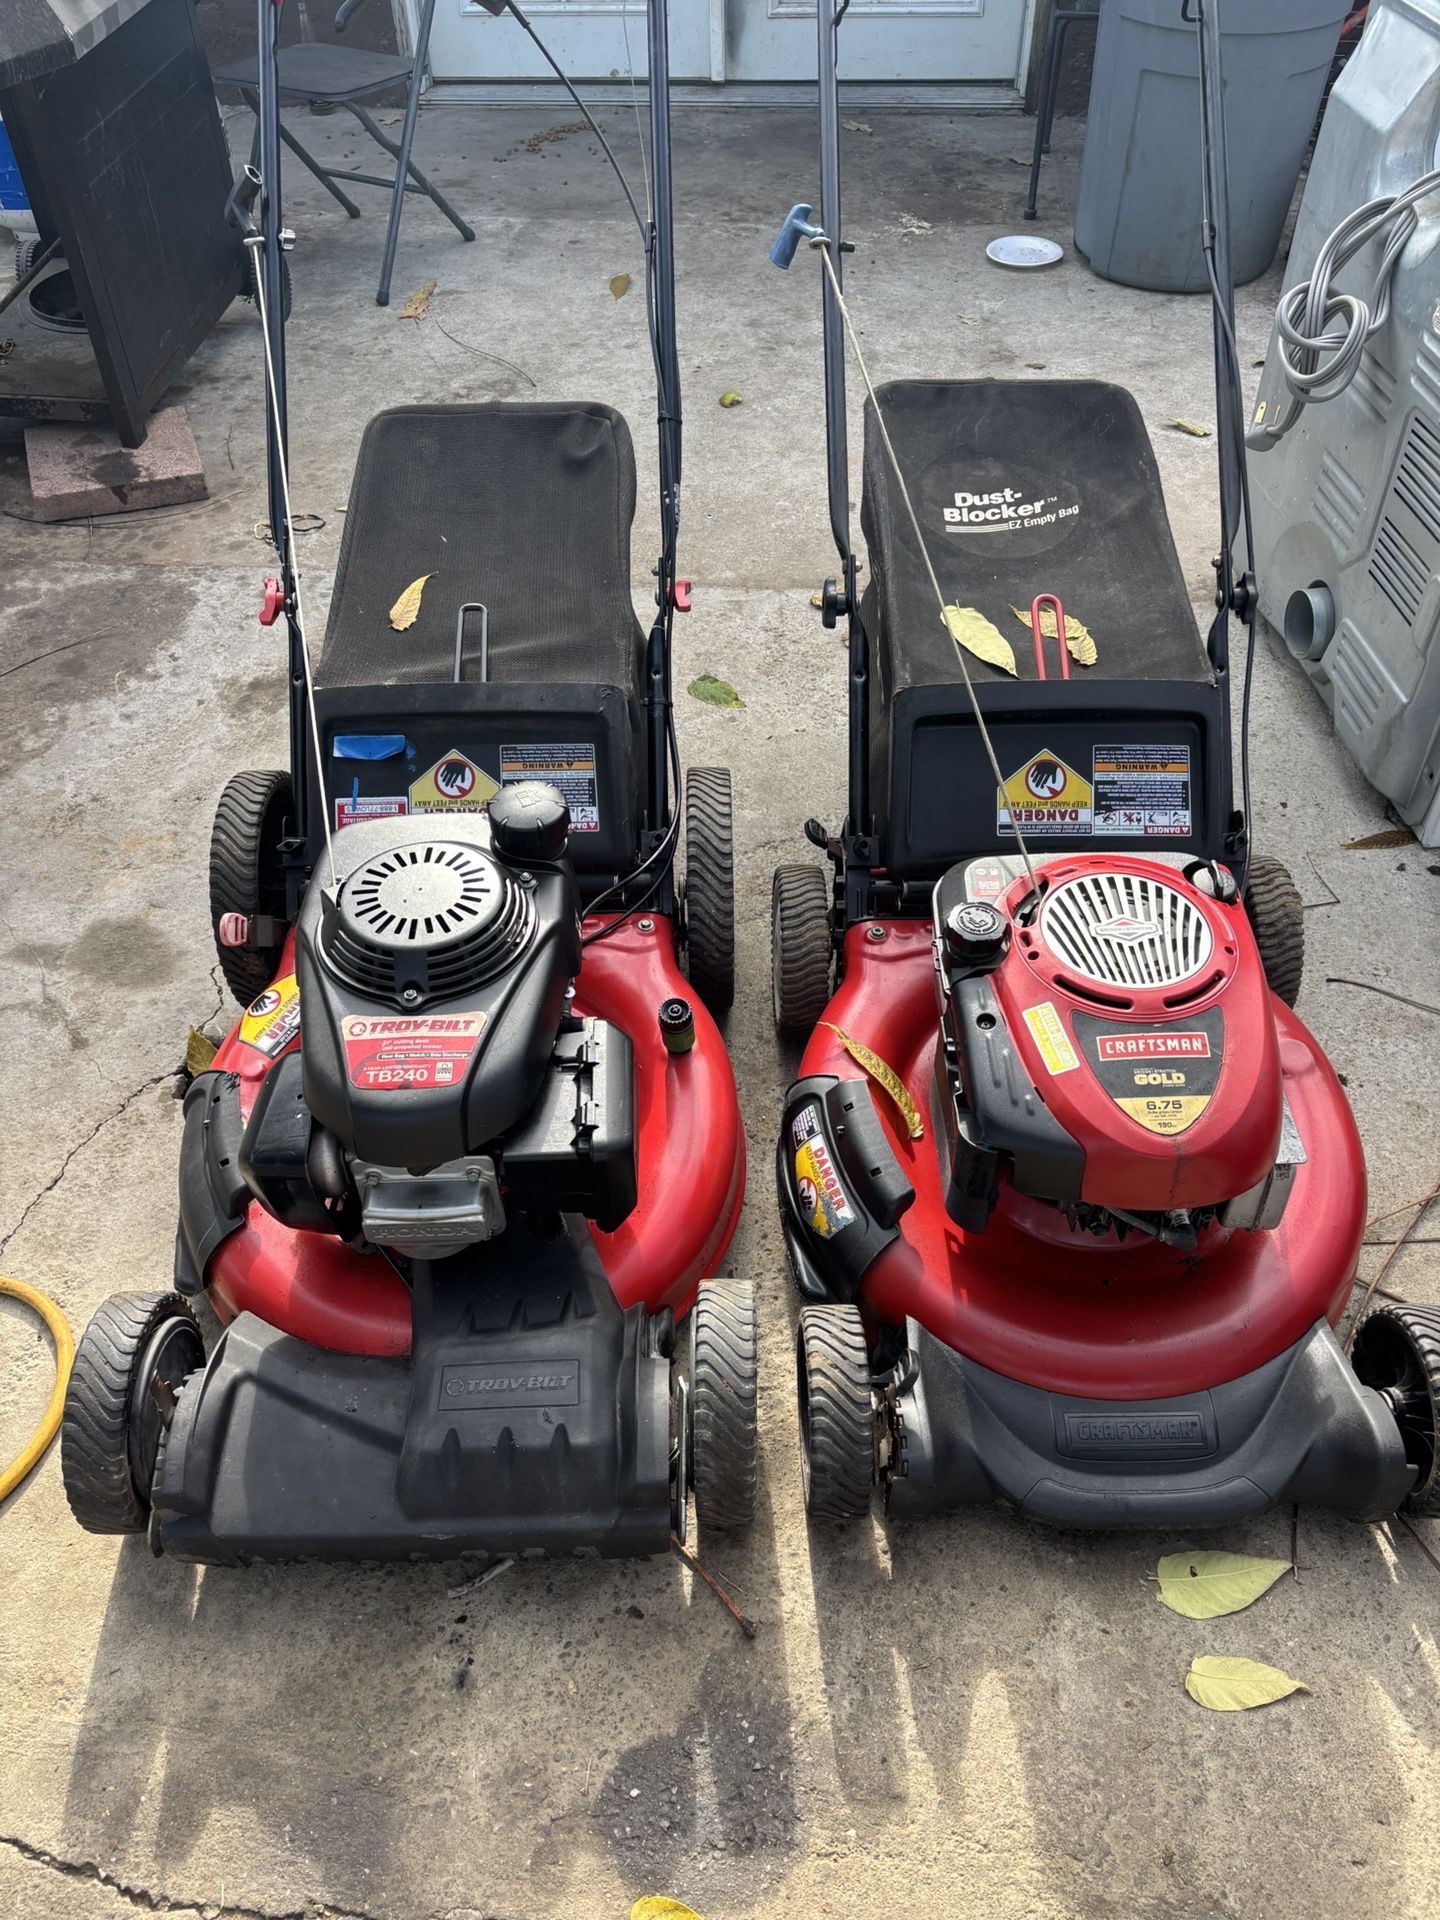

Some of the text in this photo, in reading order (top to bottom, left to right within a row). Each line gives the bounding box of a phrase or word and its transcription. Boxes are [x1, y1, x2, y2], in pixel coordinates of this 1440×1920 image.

[954, 488, 1022, 507] Dust-
[943, 500, 1045, 522] Blocker
[1008, 504, 1080, 530] EZ Empty Bag
[414, 799, 432, 807] AWAY
[432, 799, 447, 807] FEET
[447, 799, 459, 807] and
[459, 799, 480, 807] HANDS
[1022, 800, 1037, 808] FEET
[1038, 800, 1049, 808] and
[1049, 800, 1071, 808] HANDS
[1071, 800, 1088, 808] KEEP
[1012, 809, 1079, 821] DANGER
[1147, 826, 1181, 834] DANGER
[369, 1019, 475, 1034] TROY-BILT
[1105, 1038, 1203, 1054] CRAFTSMAN
[366, 1069, 429, 1083] TB240
[1133, 1073, 1186, 1085] GOLD
[1146, 1100, 1182, 1110] 6.75
[813, 1146, 846, 1212] DANGER
[466, 1375, 575, 1394] TROY-BILT
[1077, 1421, 1195, 1440] CRAFTSMAN
